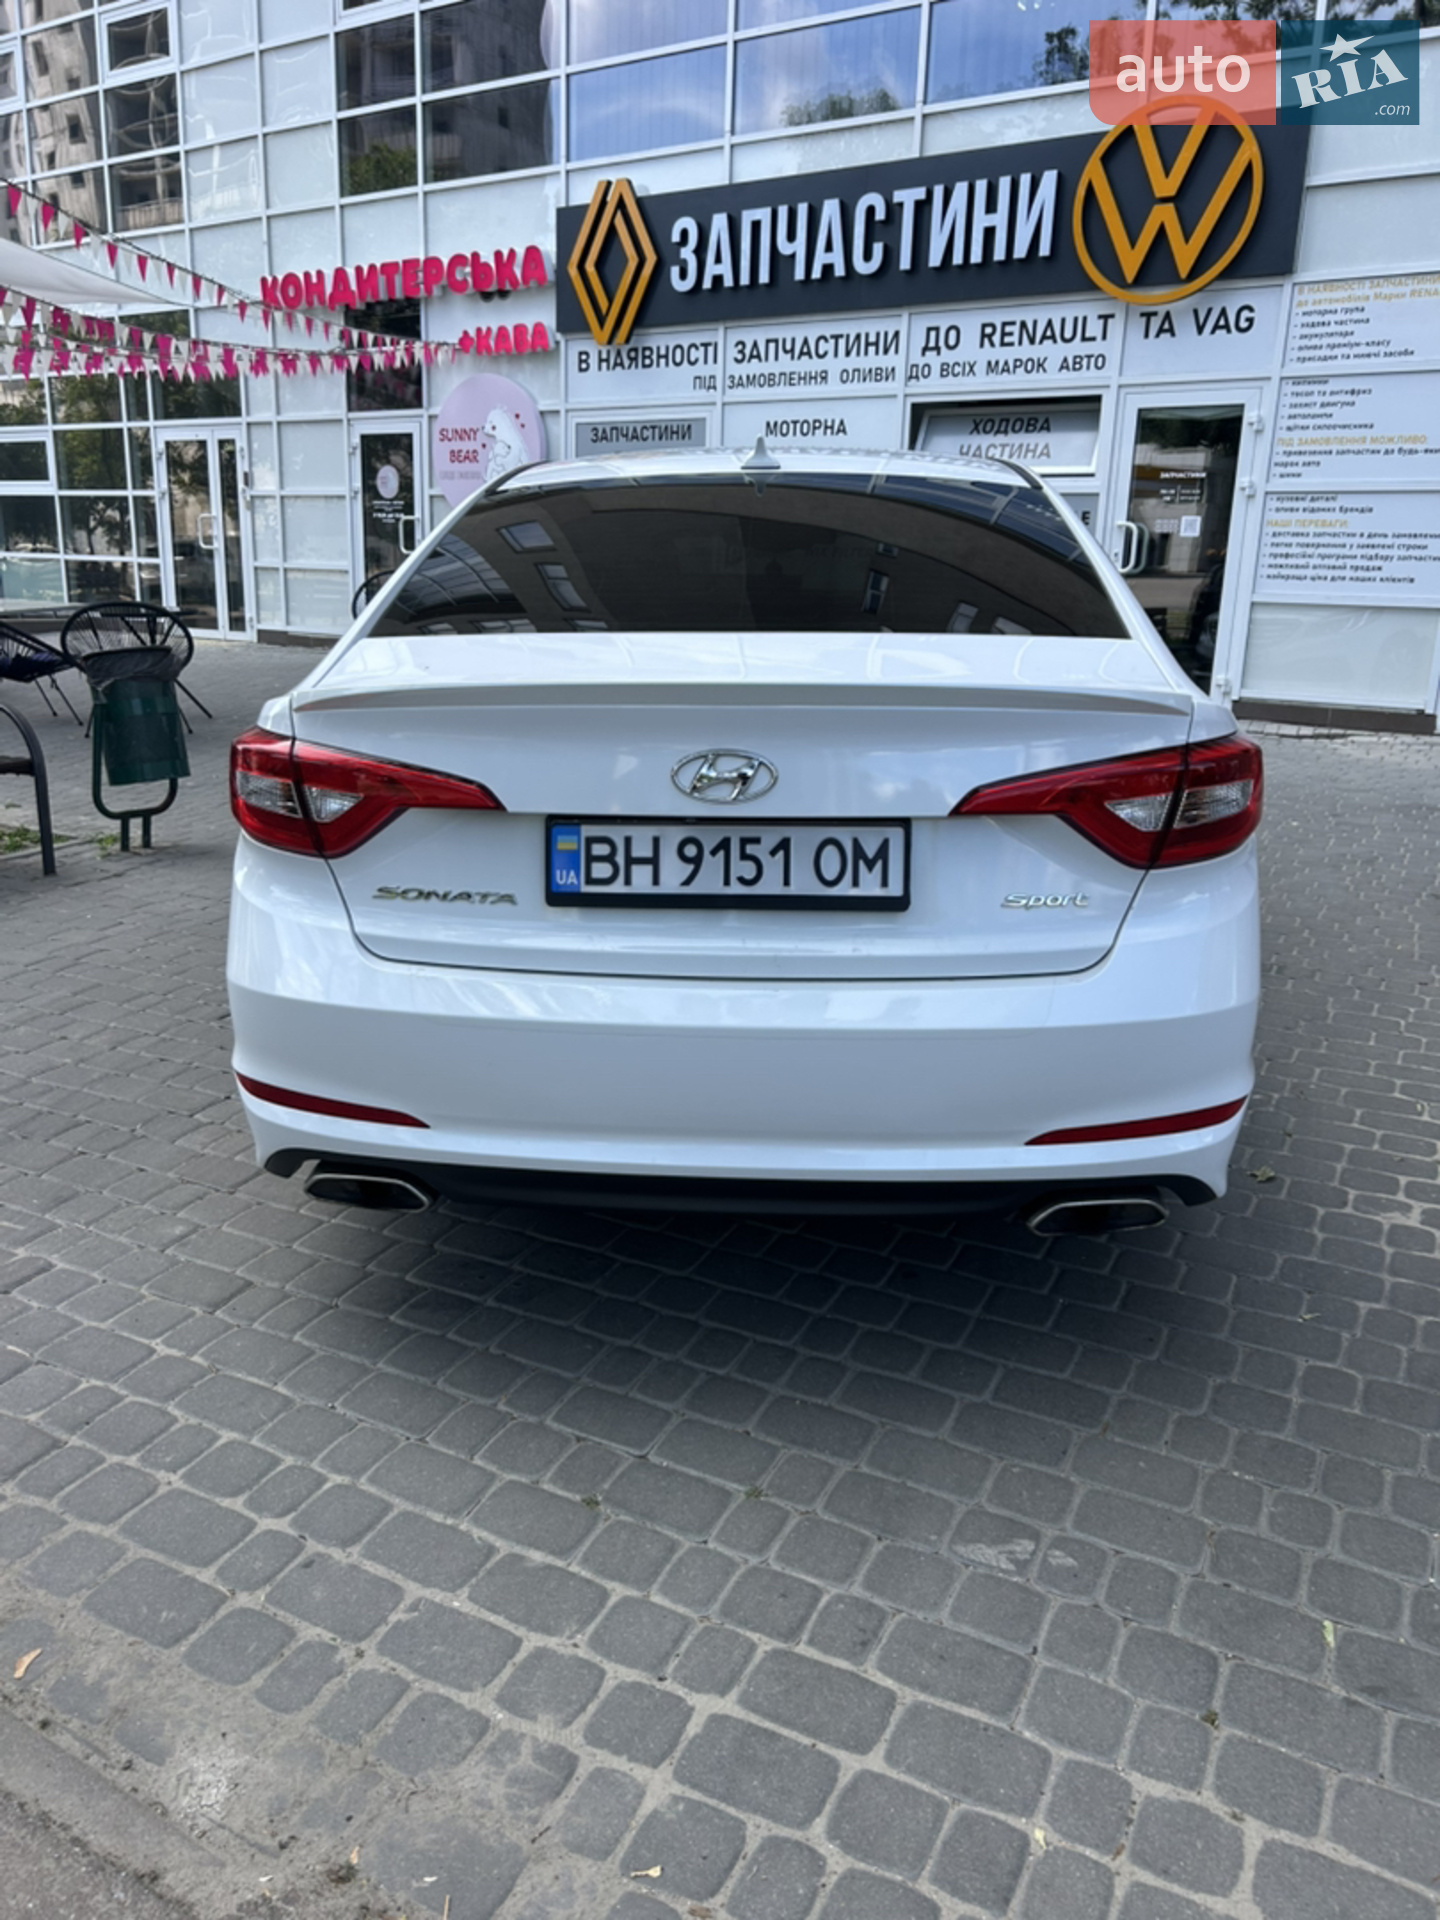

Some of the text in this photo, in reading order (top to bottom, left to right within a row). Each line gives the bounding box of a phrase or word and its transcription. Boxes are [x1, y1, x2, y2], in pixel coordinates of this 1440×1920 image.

[669, 169, 1060, 293] ЗАПЧАСТИНИ
[260, 245, 548, 312] КОНДИТЕРСЬКА
[458, 322, 550, 356] +КАВА
[578, 304, 1256, 373] В НАЯВНОСТІ ЗАПЧАСТИНИ ДО RENAULT ТА VAG
[693, 353, 1107, 391] ПІД ЗАМОВЛЕННЯ ОЛИВИ ДО ВСІХ МАРОК АВТО
[439, 427, 480, 442] SUNNY
[590, 424, 692, 443] ЗАПЧАСТИНИ
[765, 418, 848, 438] МОТОРНА
[969, 416, 1052, 437] ХОДОВА
[449, 449, 479, 463] BEAR
[959, 442, 1052, 460] ЧАСТИНА
[555, 870, 578, 885] UA
[677, 836, 792, 887] 9151
[372, 886, 518, 906] SONATA
[1000, 892, 1090, 910] Sport
